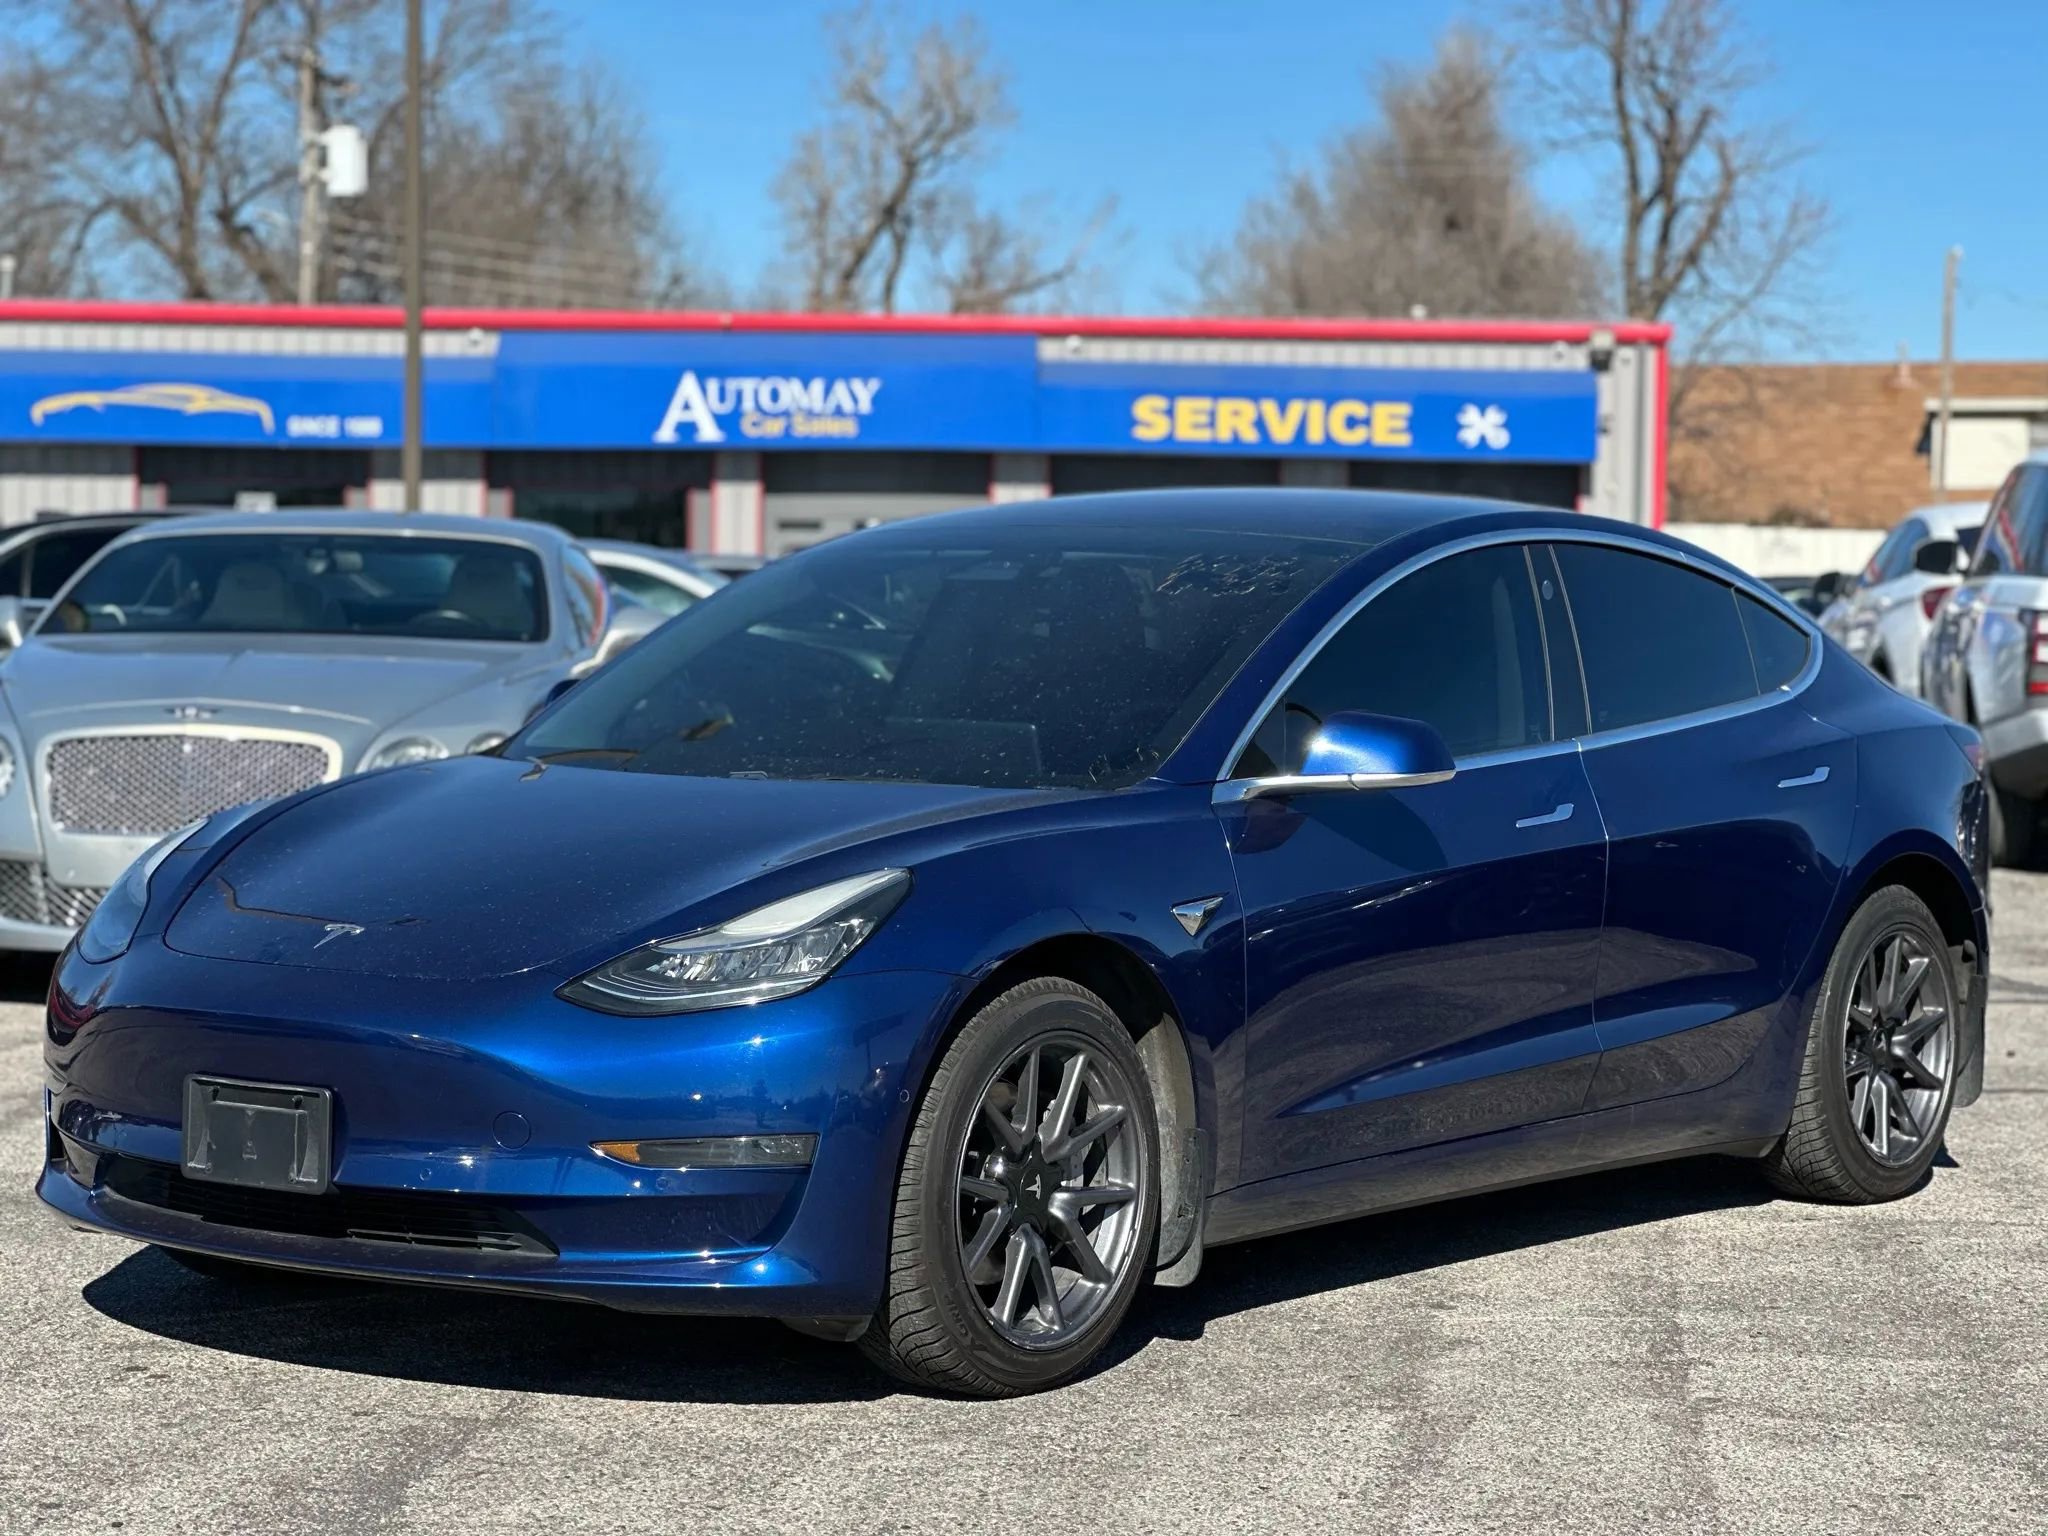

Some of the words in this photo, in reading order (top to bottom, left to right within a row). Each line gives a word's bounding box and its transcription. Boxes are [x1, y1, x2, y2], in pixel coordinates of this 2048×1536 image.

[652, 370, 881, 443] AUTOMAY
[741, 411, 785, 437] Car
[1131, 395, 1412, 447] SERVICE
